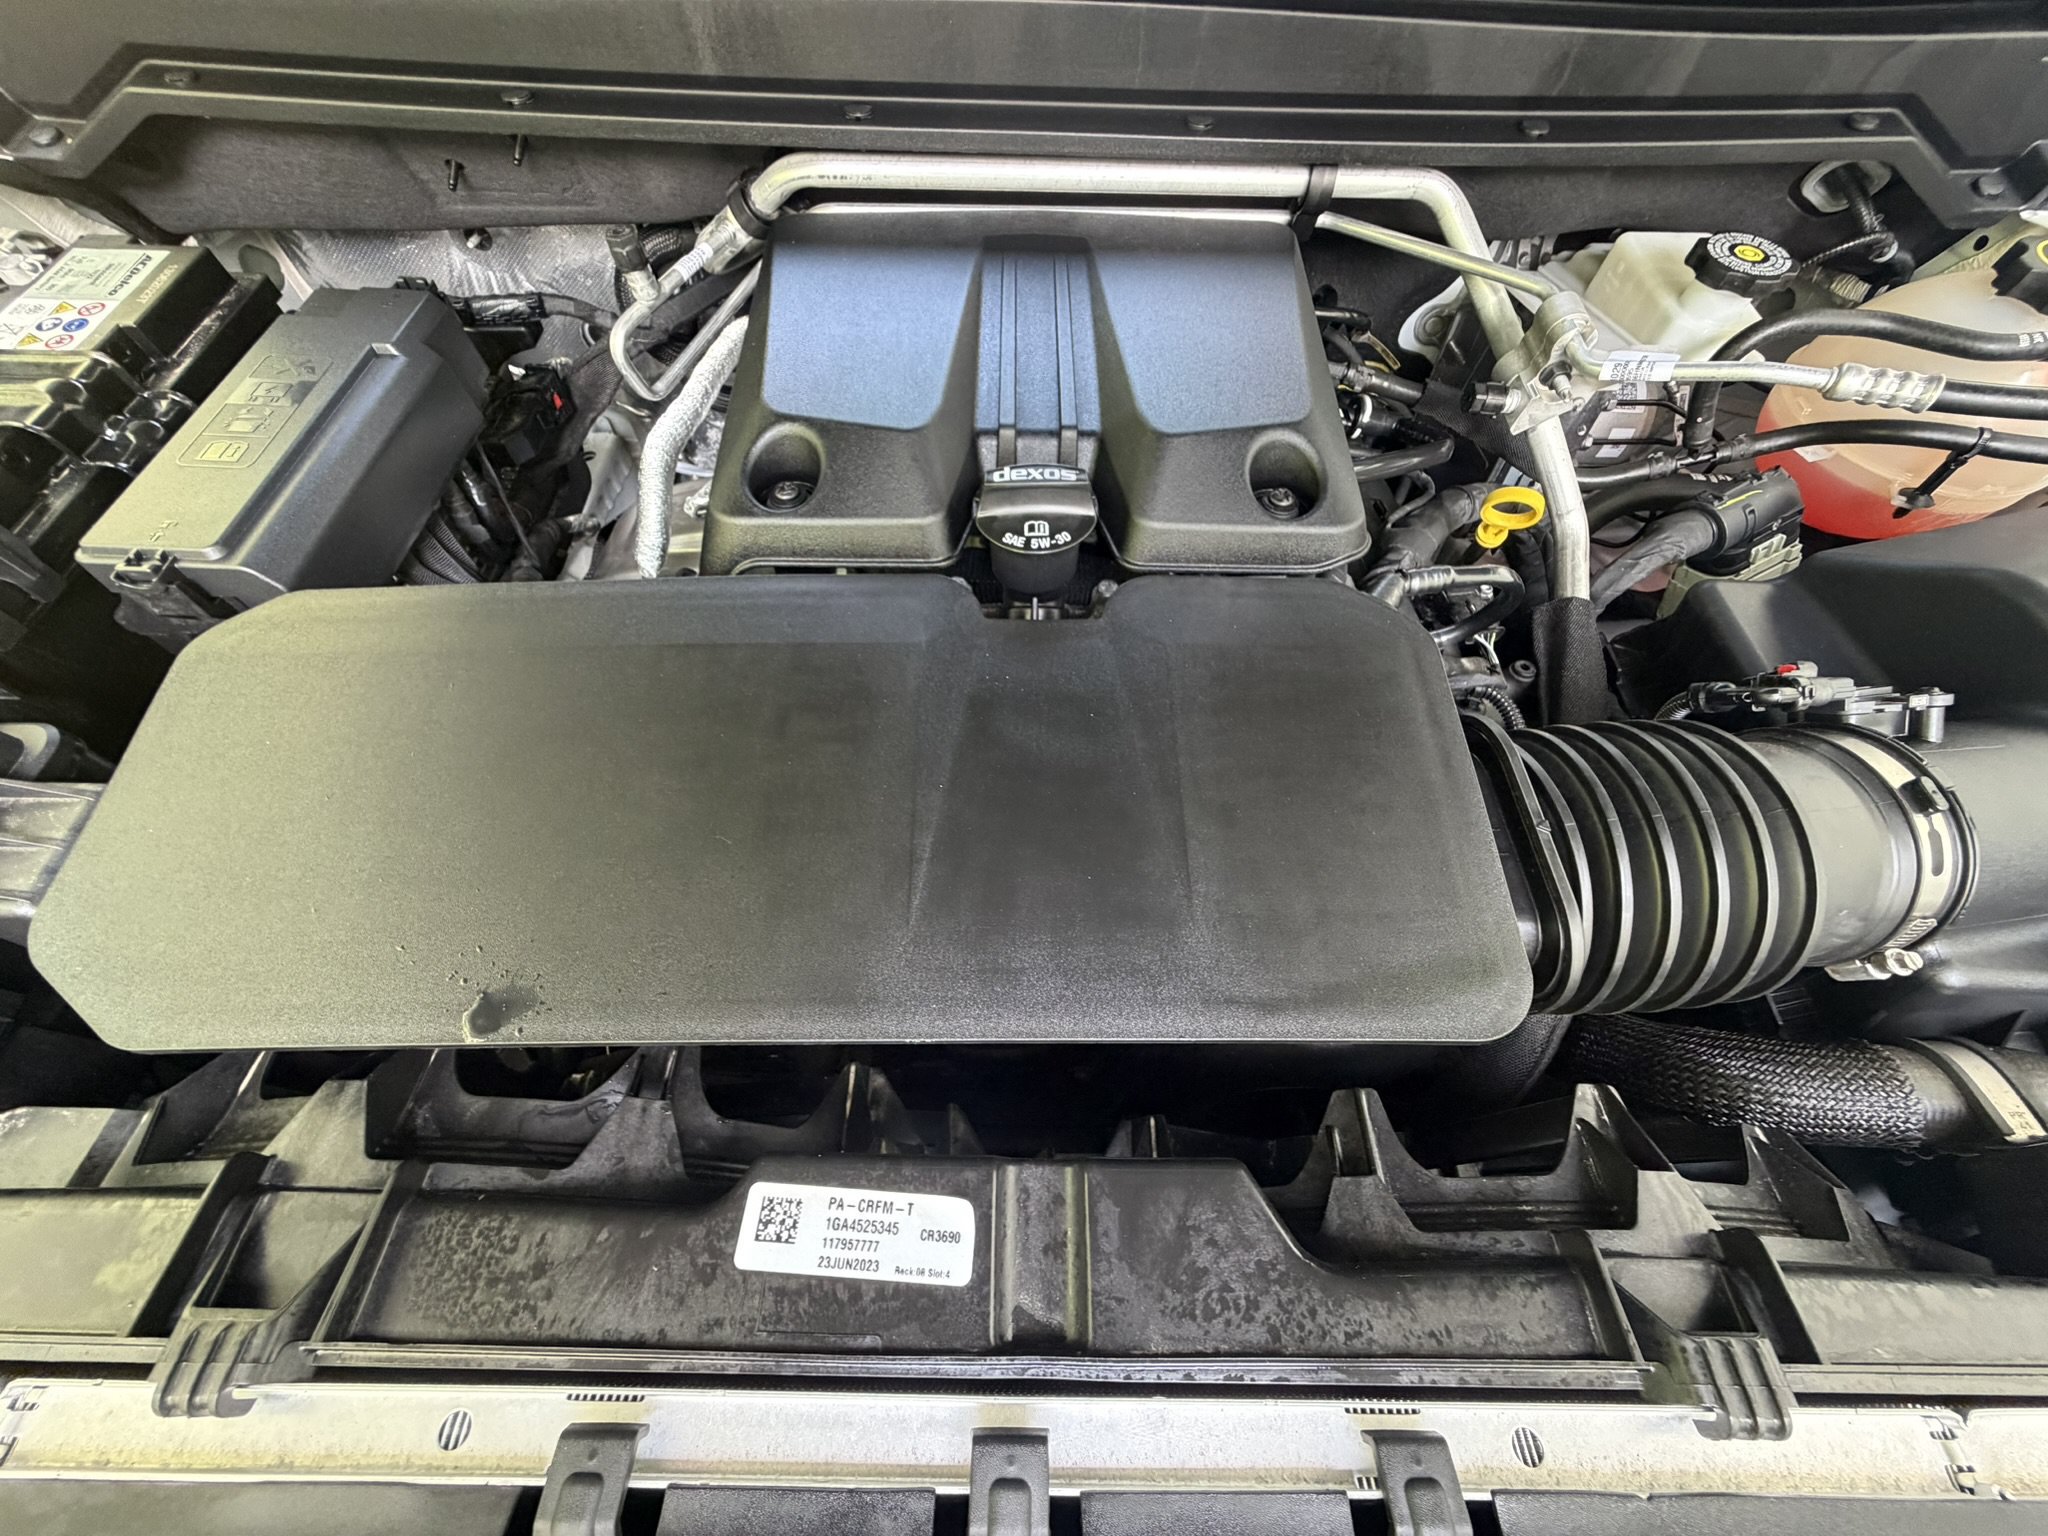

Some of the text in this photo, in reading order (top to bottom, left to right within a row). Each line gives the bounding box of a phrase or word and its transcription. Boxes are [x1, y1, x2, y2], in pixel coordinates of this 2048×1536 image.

[108, 254, 153, 296] ACDelco
[992, 466, 1077, 482] dexos
[1001, 531, 1072, 549] SAE 5W-30
[826, 1216, 900, 1236] 1GA4525345
[821, 1236, 880, 1253] 117957777
[919, 1228, 961, 1244] CR3690
[816, 1255, 880, 1273] 23JUN2023
